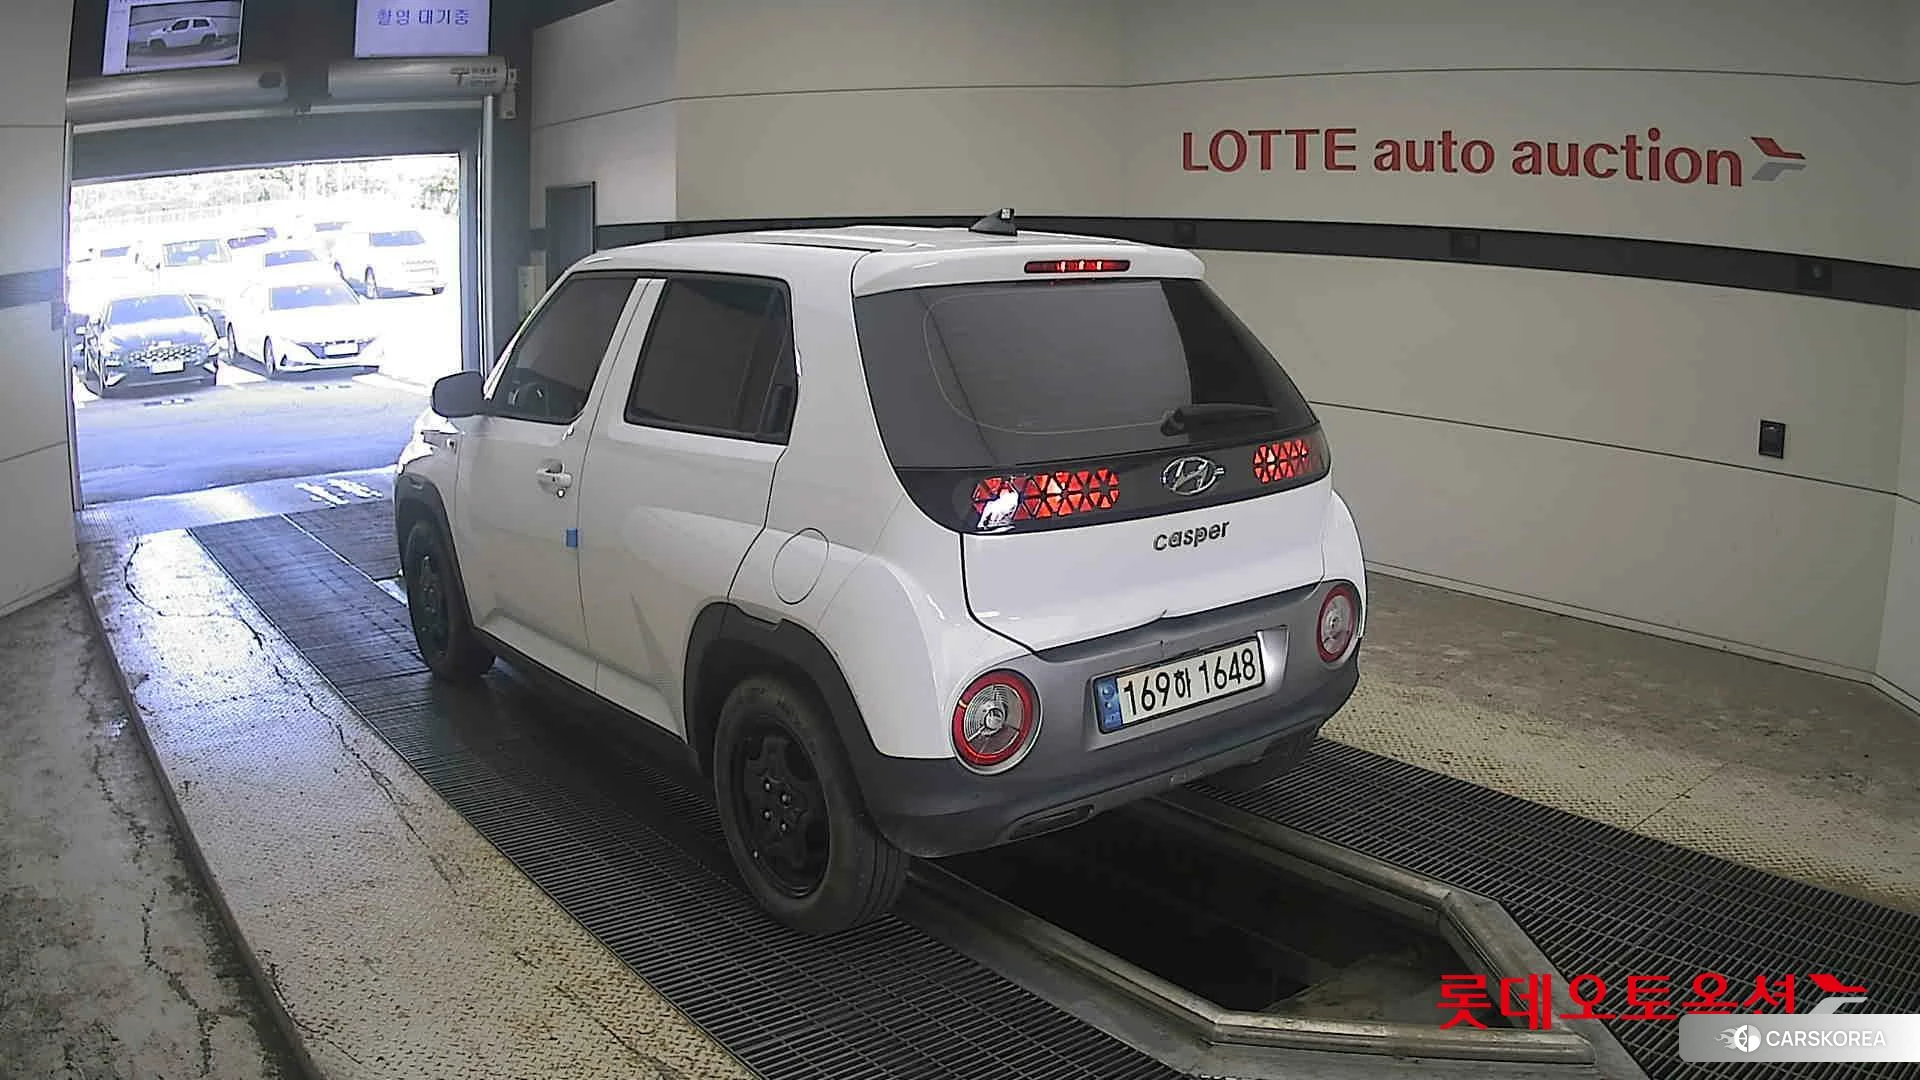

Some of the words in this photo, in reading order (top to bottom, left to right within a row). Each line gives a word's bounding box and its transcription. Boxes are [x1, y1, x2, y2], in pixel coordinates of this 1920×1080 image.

[418, 8, 469, 26] 대기중
[1183, 128, 1356, 172] LOTTE
[1374, 130, 1495, 174] auto
[1511, 127, 1742, 187] auction
[1153, 521, 1230, 550] casper
[1123, 667, 1192, 716] 169하
[1198, 648, 1256, 694] 1648
